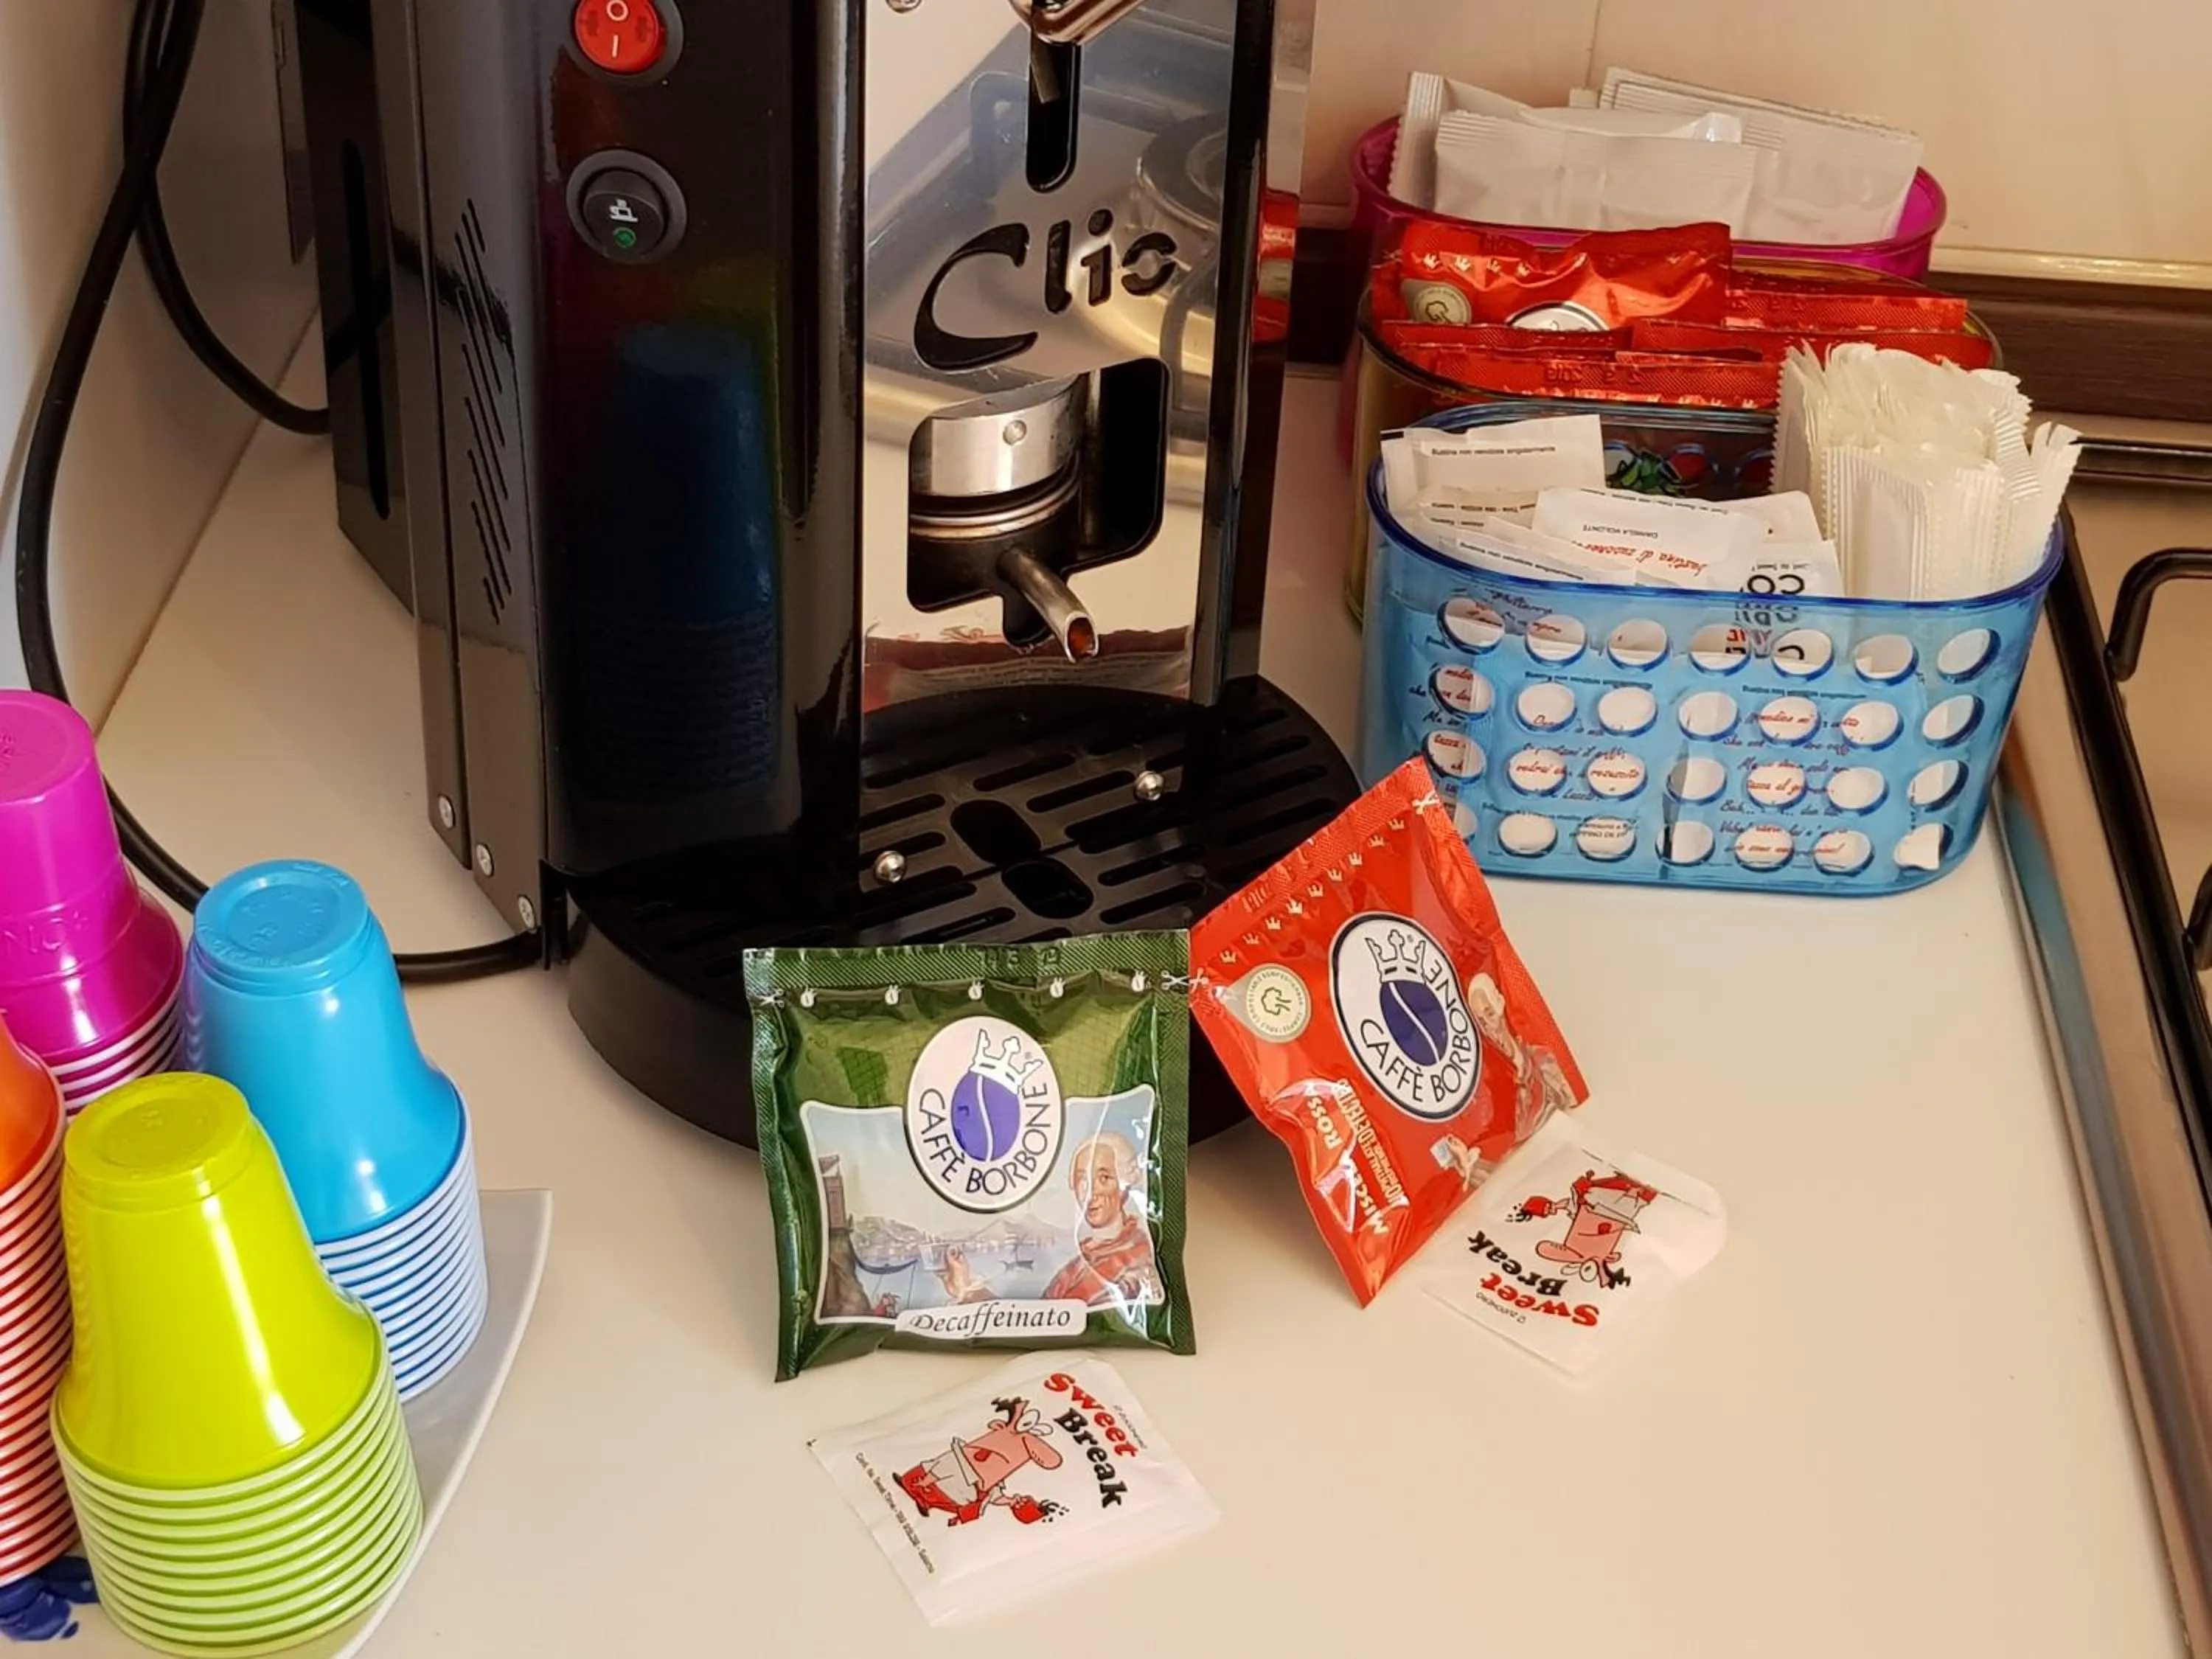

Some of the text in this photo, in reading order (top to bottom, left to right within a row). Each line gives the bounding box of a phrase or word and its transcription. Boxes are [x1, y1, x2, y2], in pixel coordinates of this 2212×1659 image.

[914, 209, 1178, 369] Clio
[1360, 1018, 1425, 1103] CAFFÈ
[1429, 958, 1471, 1103] BORBONE
[919, 1082, 1052, 1196] CAFFÈ BORBONE
[1467, 1230, 1569, 1297] Break
[1478, 1272, 1601, 1327] Sweet
[908, 1302, 1071, 1337] Decaffeinato
[1043, 1371, 1139, 1458] Sweet
[1054, 1407, 1129, 1509] Break
